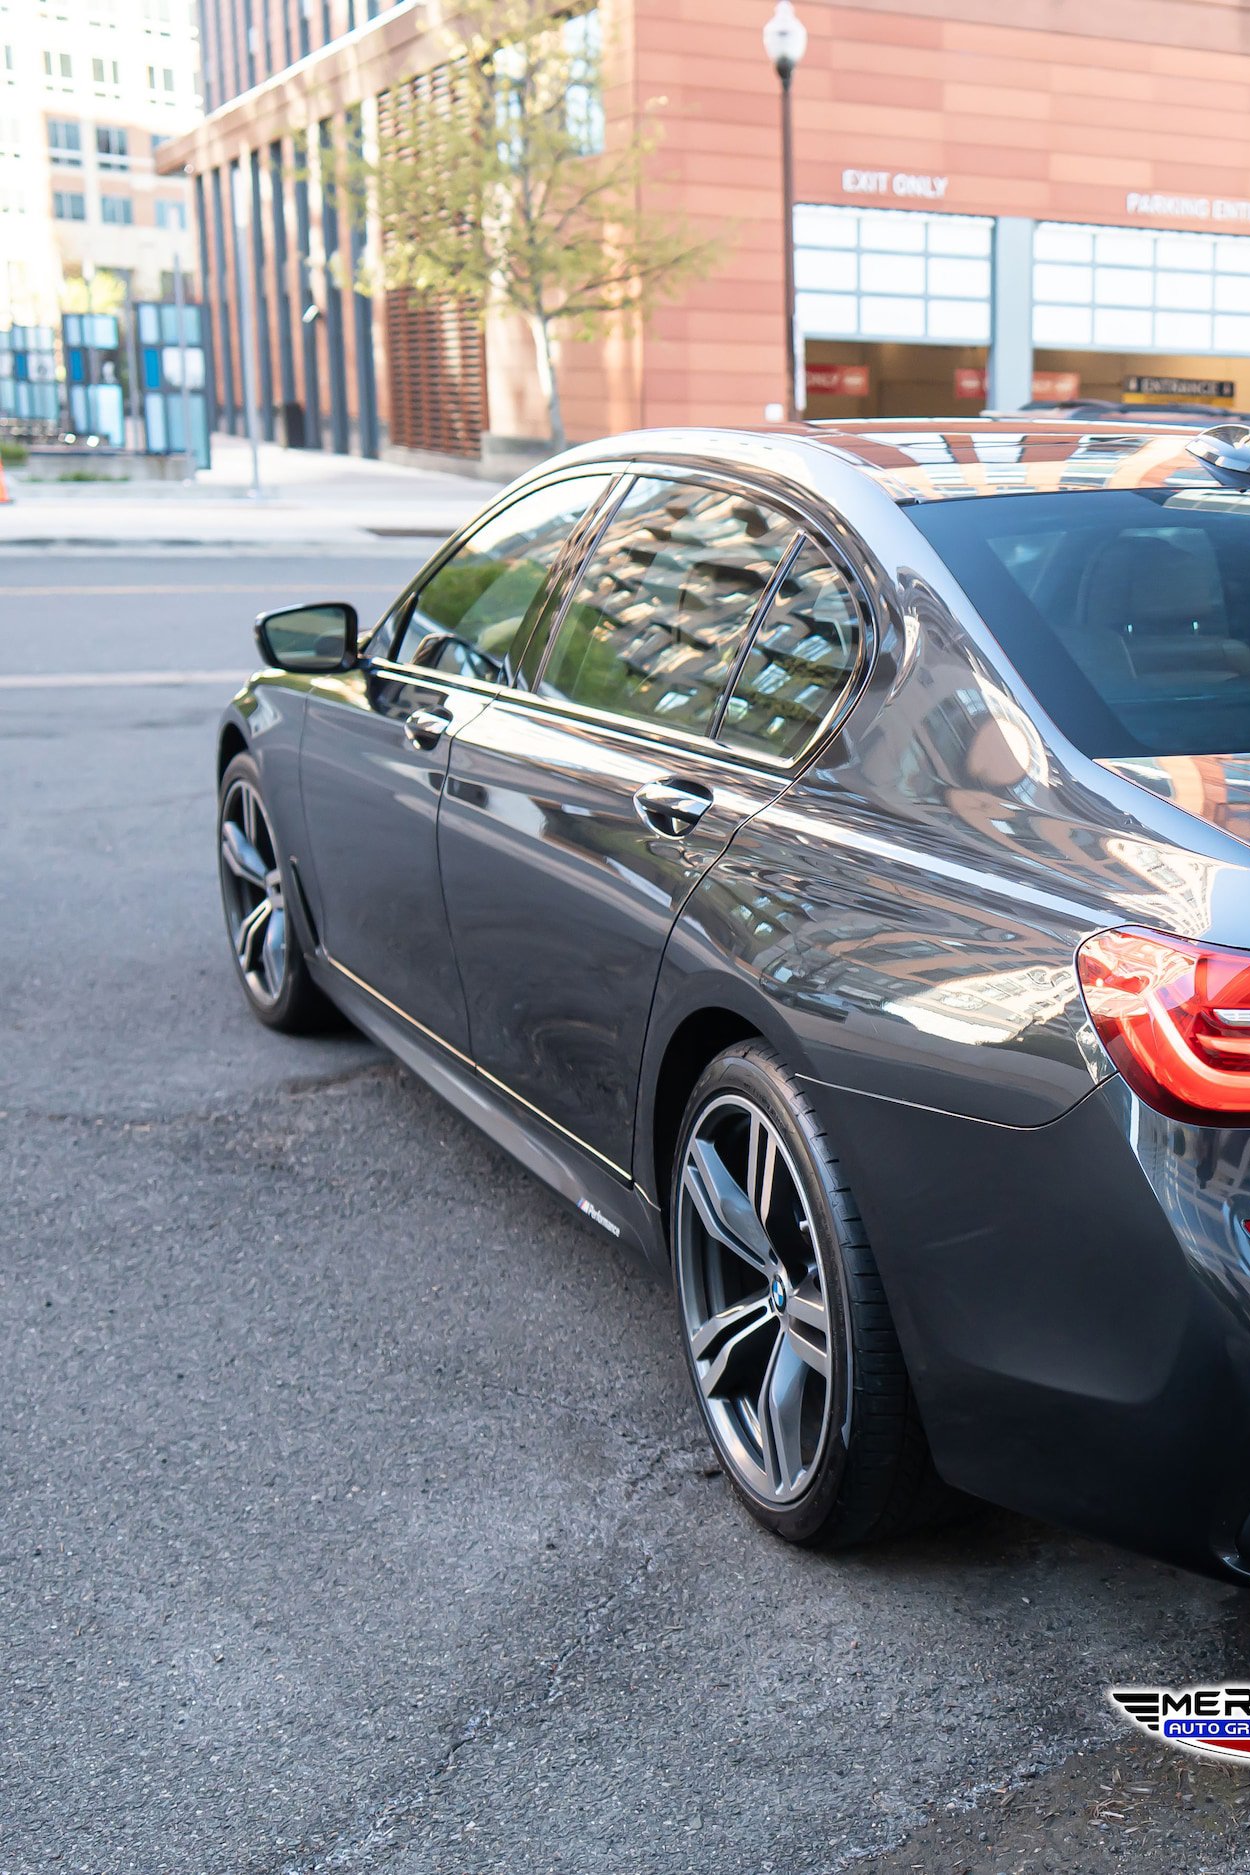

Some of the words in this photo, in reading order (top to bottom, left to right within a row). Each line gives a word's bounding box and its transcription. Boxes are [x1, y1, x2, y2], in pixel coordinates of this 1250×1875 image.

[842, 169, 890, 193] EXIT
[892, 173, 948, 199] ONLY
[1126, 192, 1209, 218] PARKING
[1140, 378, 1217, 395] ENTRANCE
